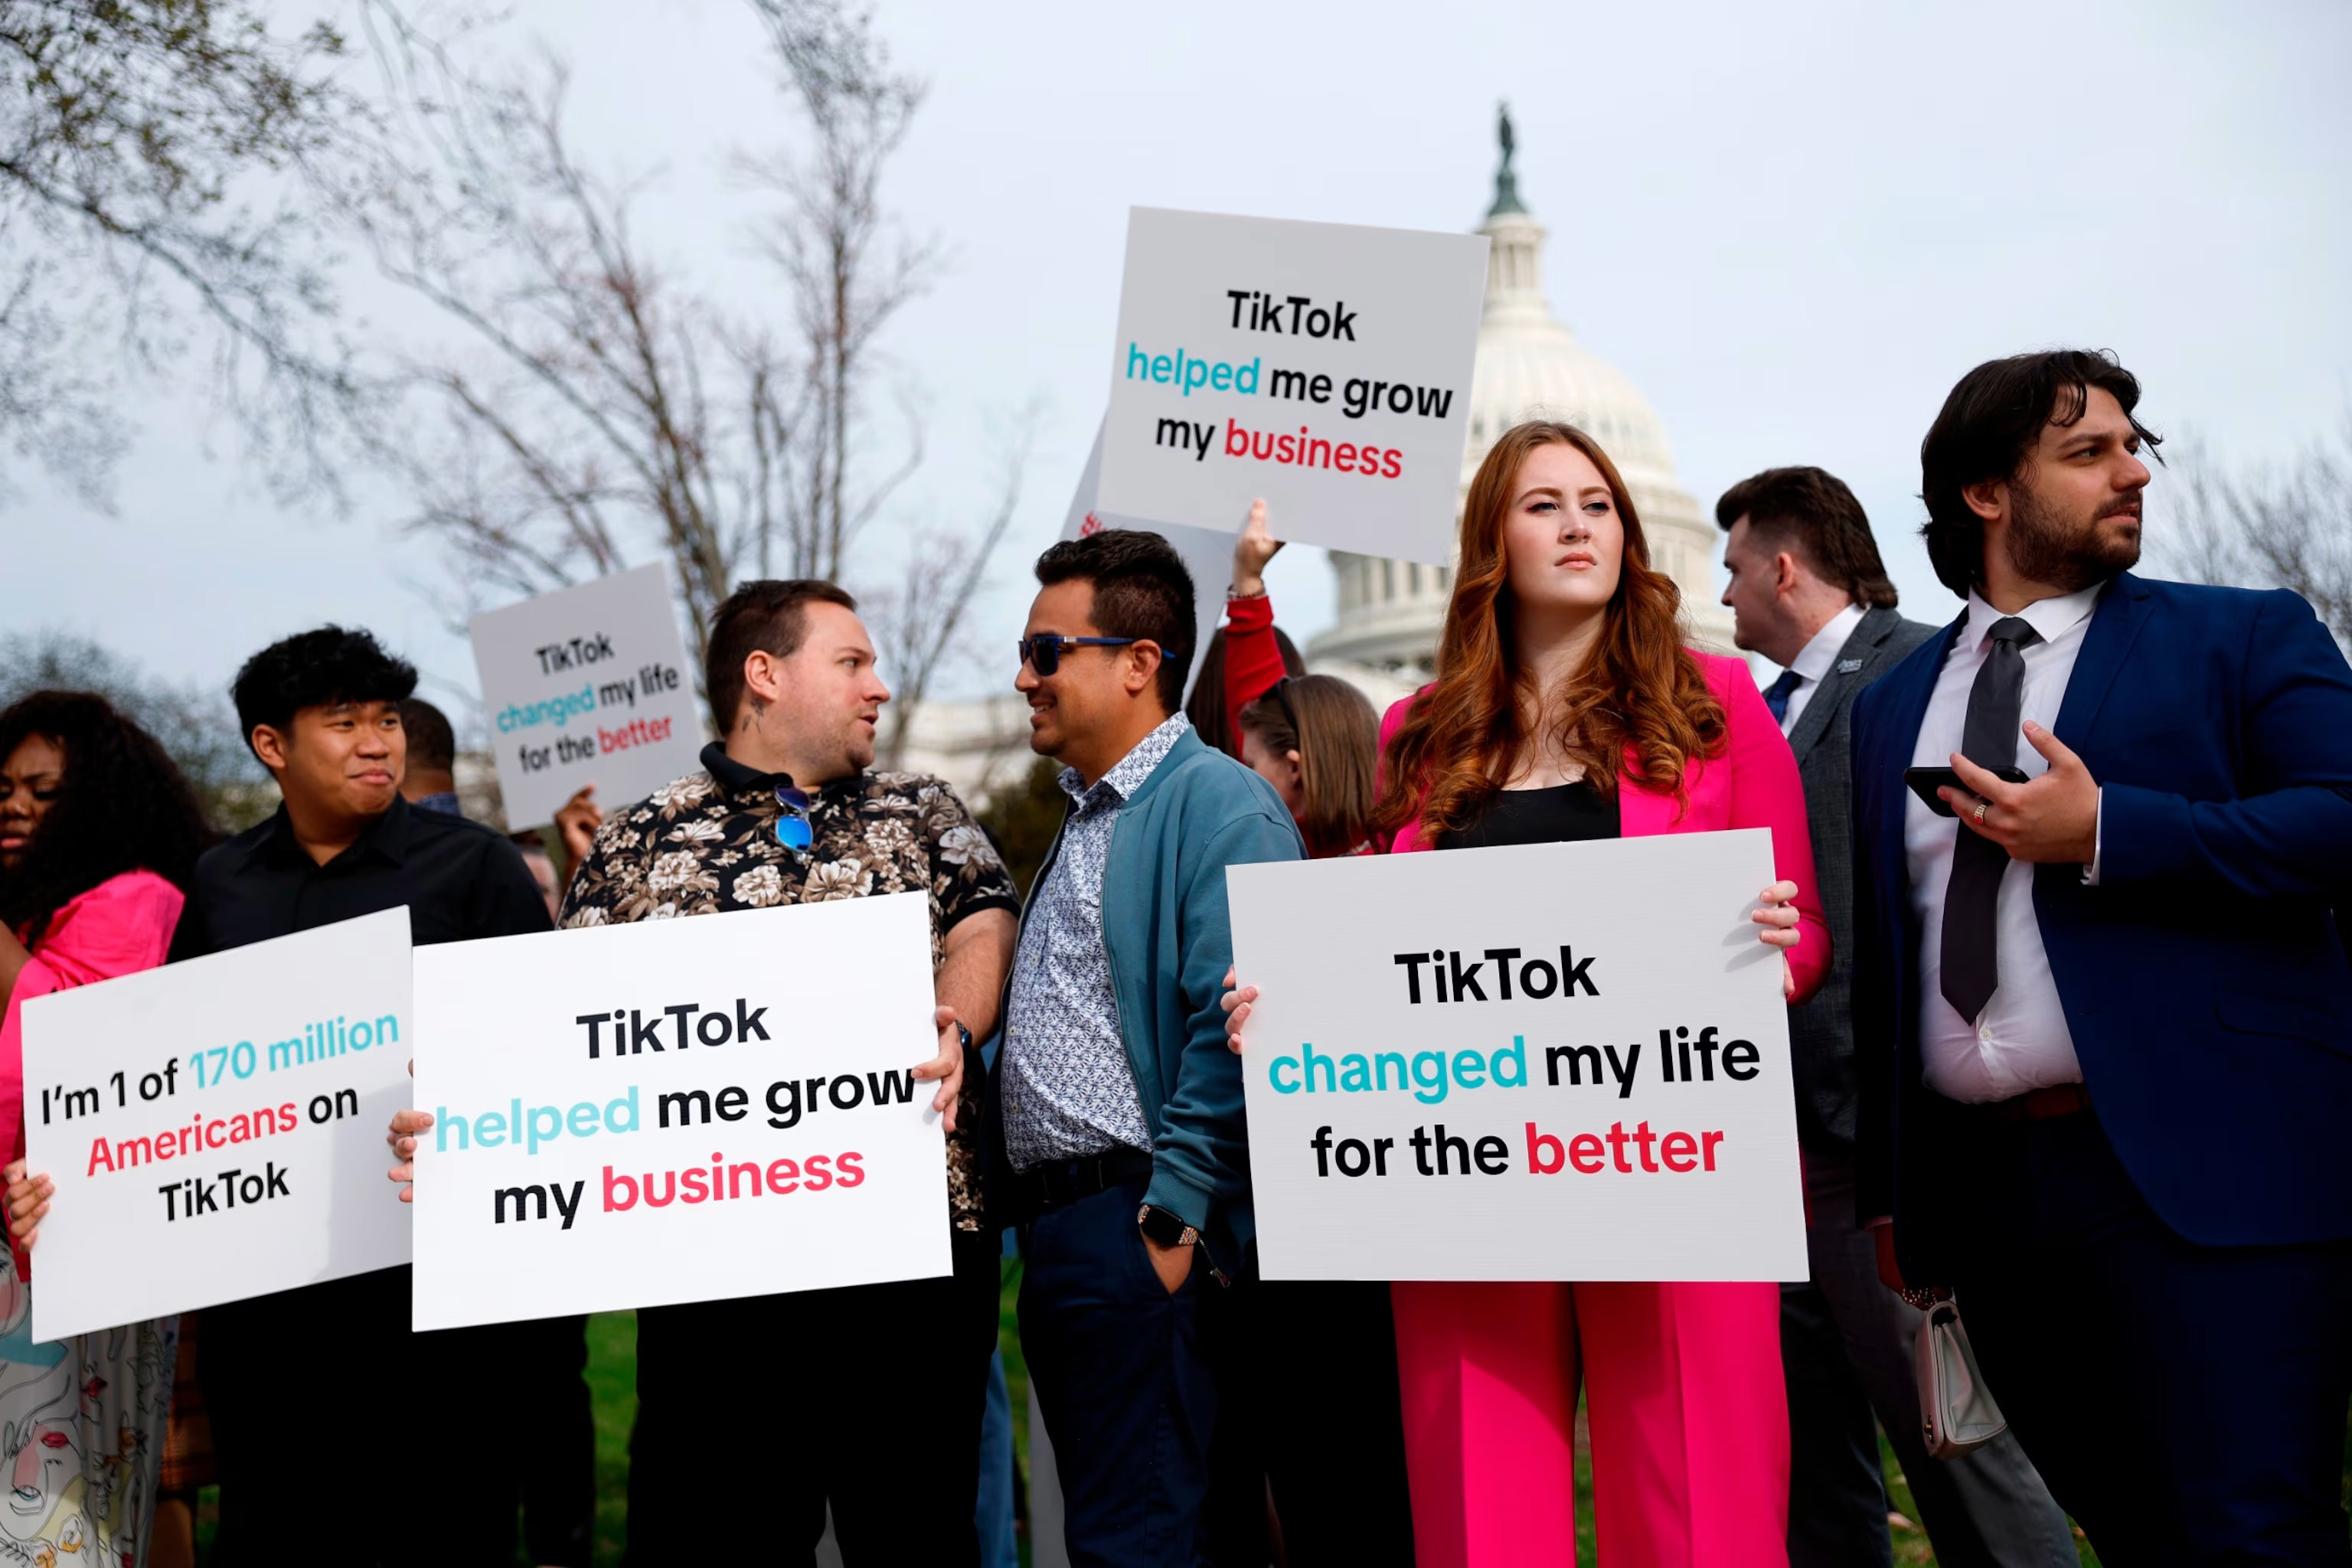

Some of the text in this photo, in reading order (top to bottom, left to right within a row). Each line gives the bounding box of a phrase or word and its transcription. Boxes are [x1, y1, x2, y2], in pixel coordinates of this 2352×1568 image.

[1227, 289, 1357, 341] TikTok
[1126, 341, 1453, 419] helped me grow
[1155, 417, 1403, 479] my business
[535, 633, 615, 675] TikTok
[497, 664, 679, 733] changed my life
[519, 717, 672, 773] for the better
[1394, 946, 1600, 1004] TikTok
[577, 998, 771, 1059] TikTok
[109, 1071, 127, 1107] 1
[139, 1057, 178, 1101] of
[189, 1041, 257, 1089] 170
[268, 1014, 399, 1072] million
[1269, 1026, 1760, 1105] changed my life
[87, 1088, 358, 1177] Americans on
[436, 1067, 916, 1155] helped me grow
[1311, 1120, 1723, 1177] for the better
[159, 1161, 290, 1221] TikTok
[494, 1152, 865, 1230] my business
